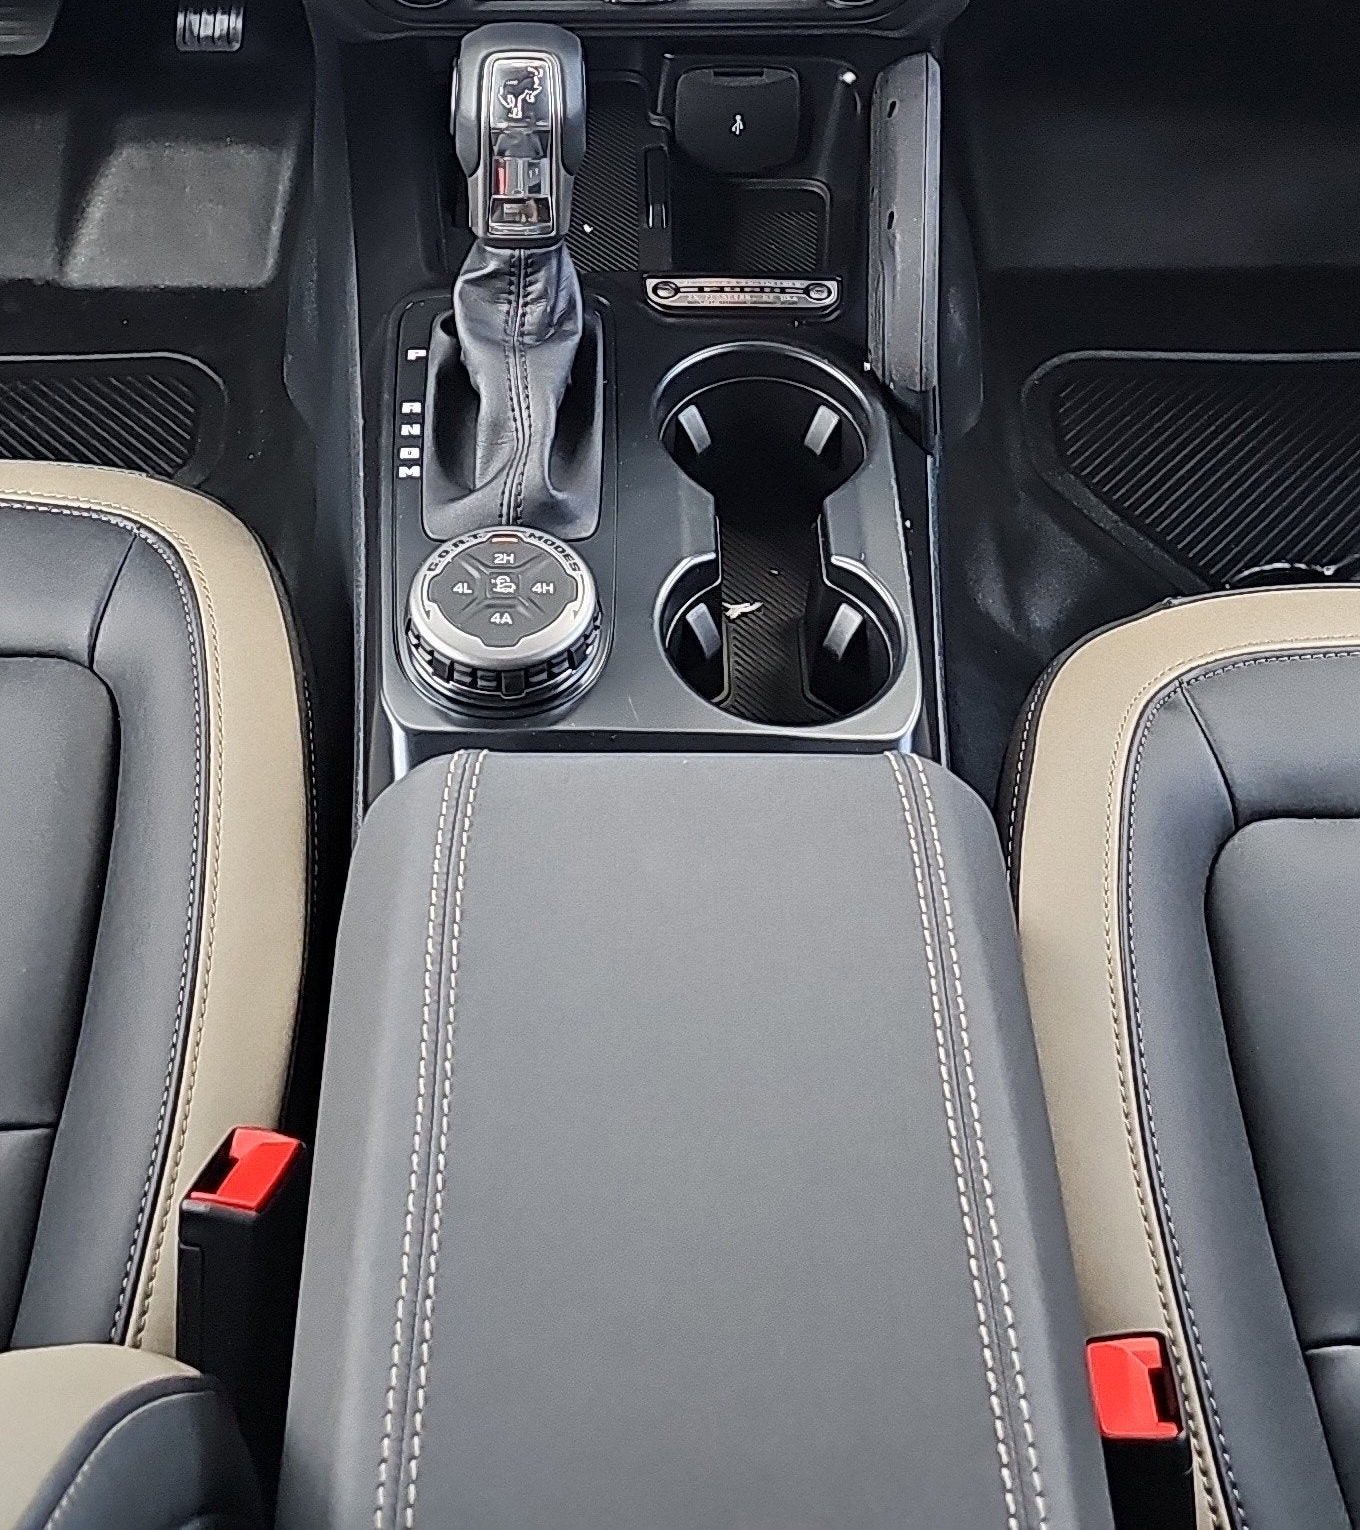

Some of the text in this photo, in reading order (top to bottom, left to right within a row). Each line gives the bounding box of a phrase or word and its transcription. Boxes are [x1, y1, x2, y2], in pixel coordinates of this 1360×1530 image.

[400, 424, 421, 436] N
[398, 465, 421, 478] M
[493, 553, 515, 564] 2H
[527, 532, 582, 572] MODES
[452, 582, 473, 594] 4L
[531, 581, 554, 594] 4H
[490, 612, 513, 625] 4A
